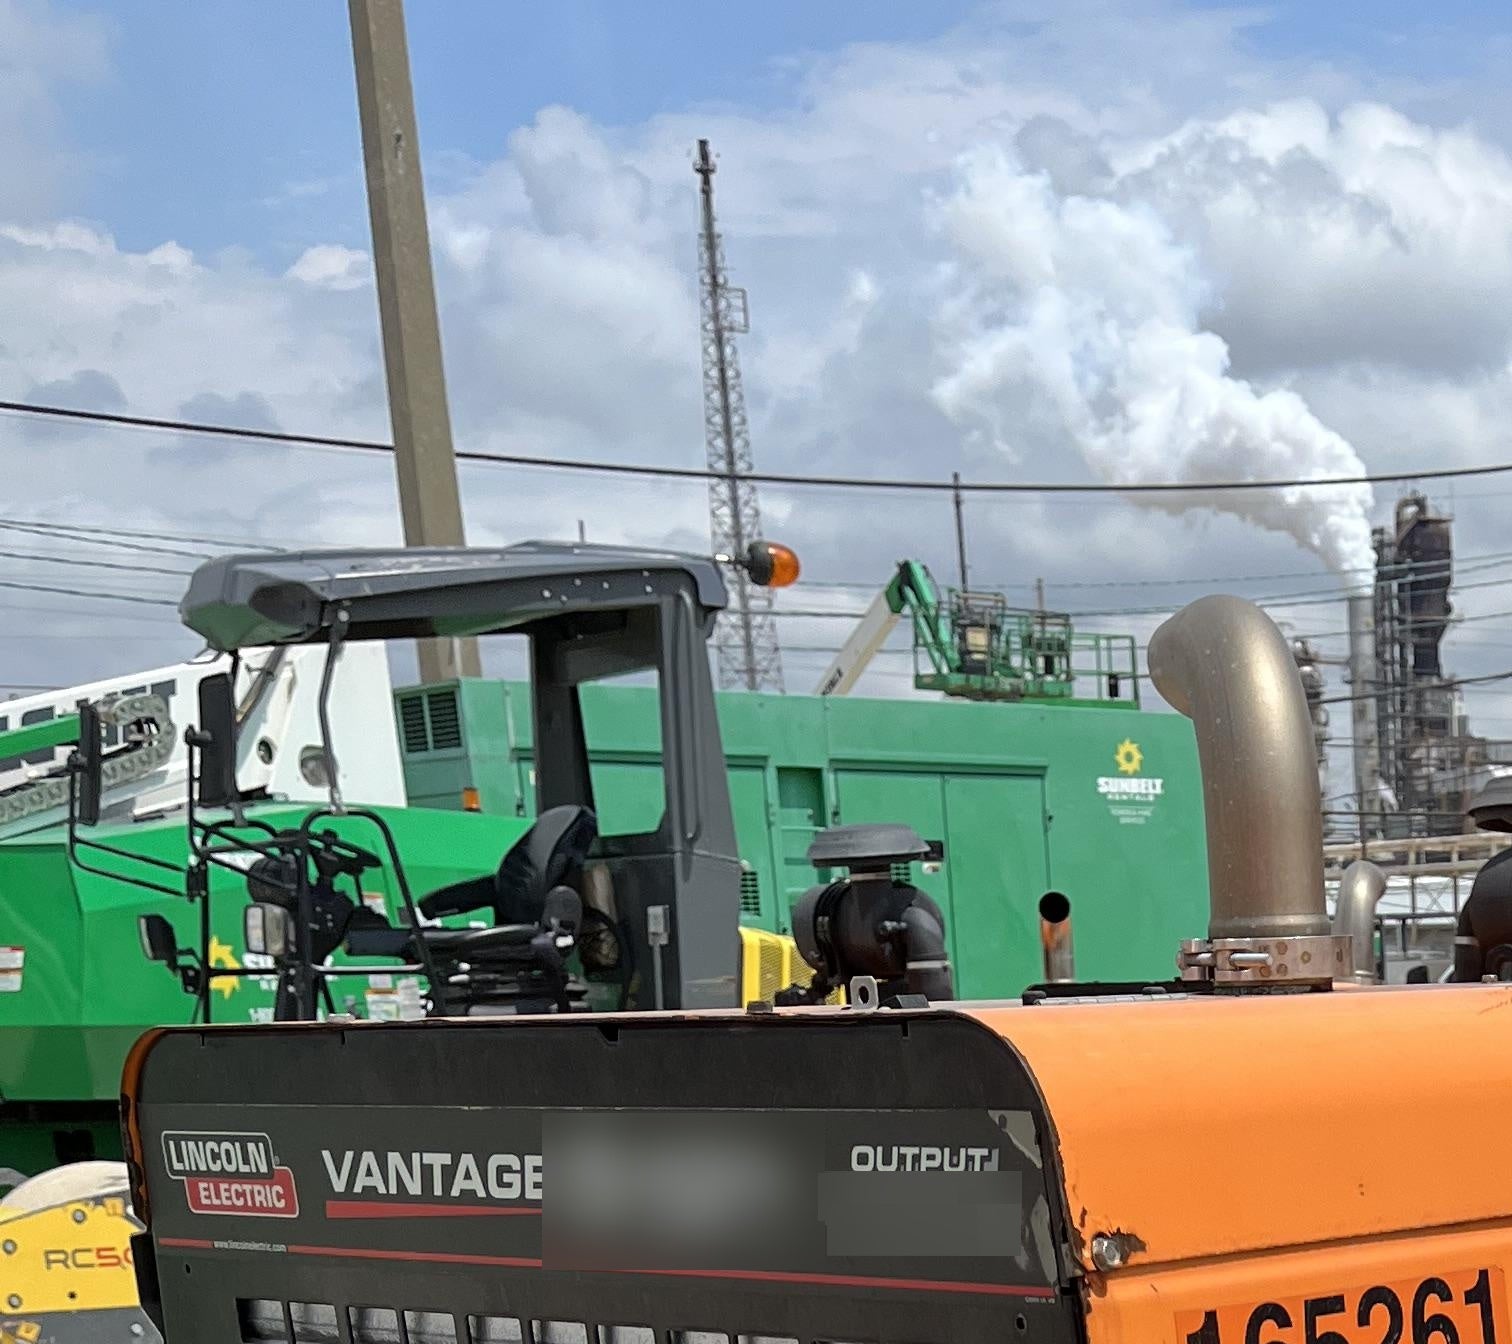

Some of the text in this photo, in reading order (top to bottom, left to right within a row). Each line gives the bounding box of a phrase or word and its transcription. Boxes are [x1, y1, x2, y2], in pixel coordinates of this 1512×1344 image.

[1096, 777, 1164, 794] SUNBELT
[168, 1140, 269, 1174] LINCOLN
[850, 1145, 989, 1172] OUTPUT
[321, 1149, 543, 1200] VANTAGE
[198, 1181, 286, 1208] ELECTRIC
